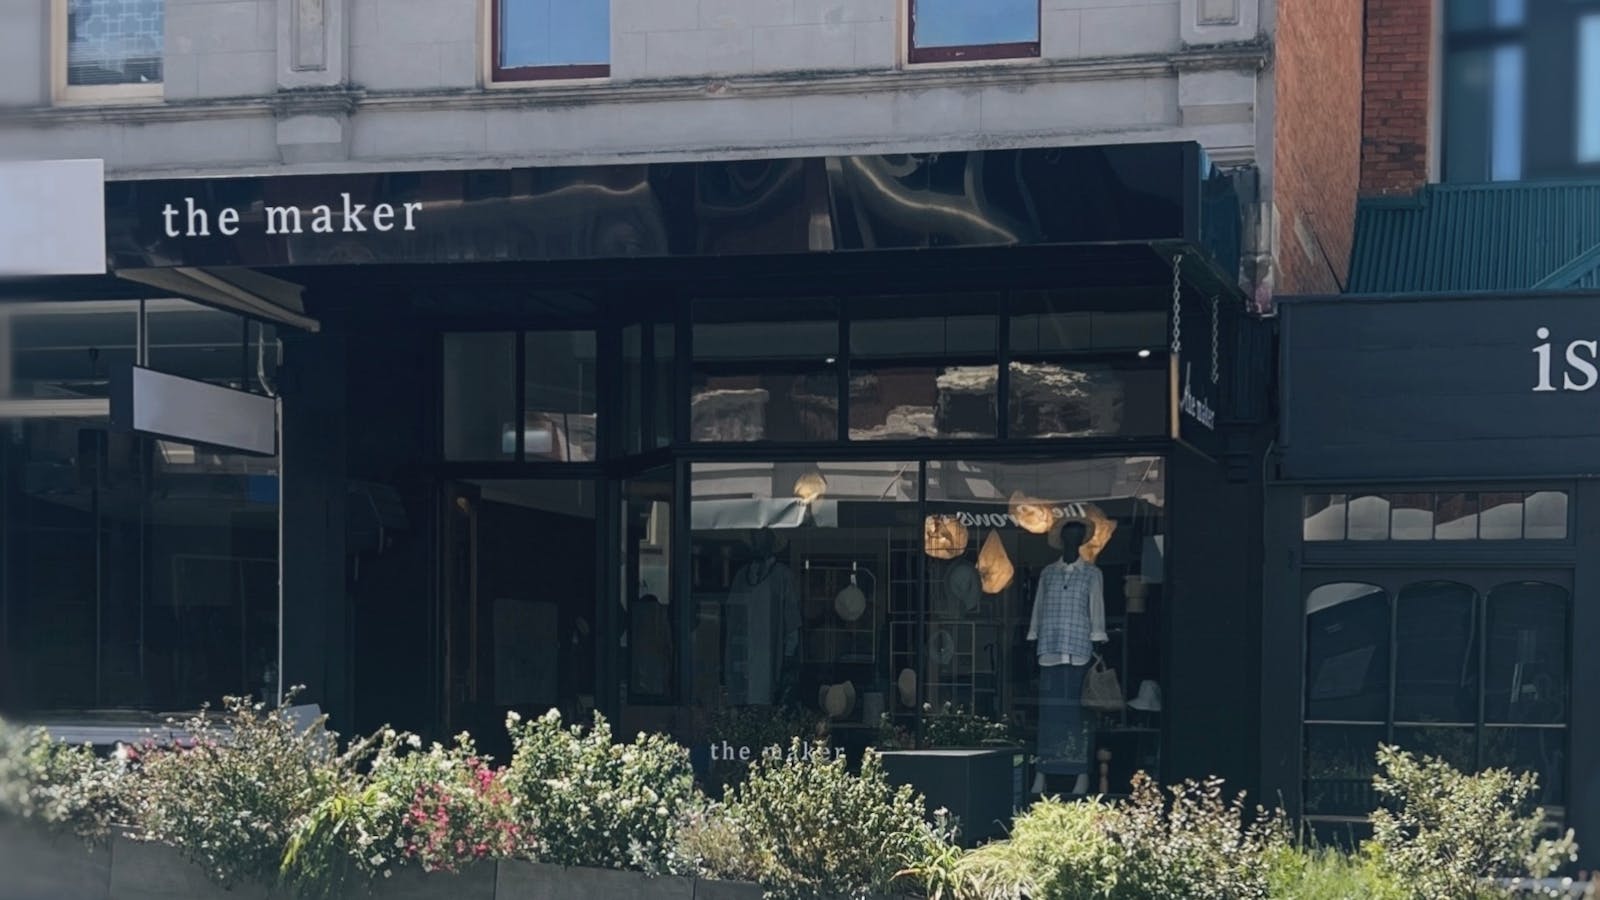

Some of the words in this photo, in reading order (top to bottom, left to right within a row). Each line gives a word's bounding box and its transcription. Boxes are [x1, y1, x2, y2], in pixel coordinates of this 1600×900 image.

[162, 197, 240, 237] the
[264, 193, 423, 234] maker
[1532, 326, 1598, 391] is
[710, 740, 751, 760] the
